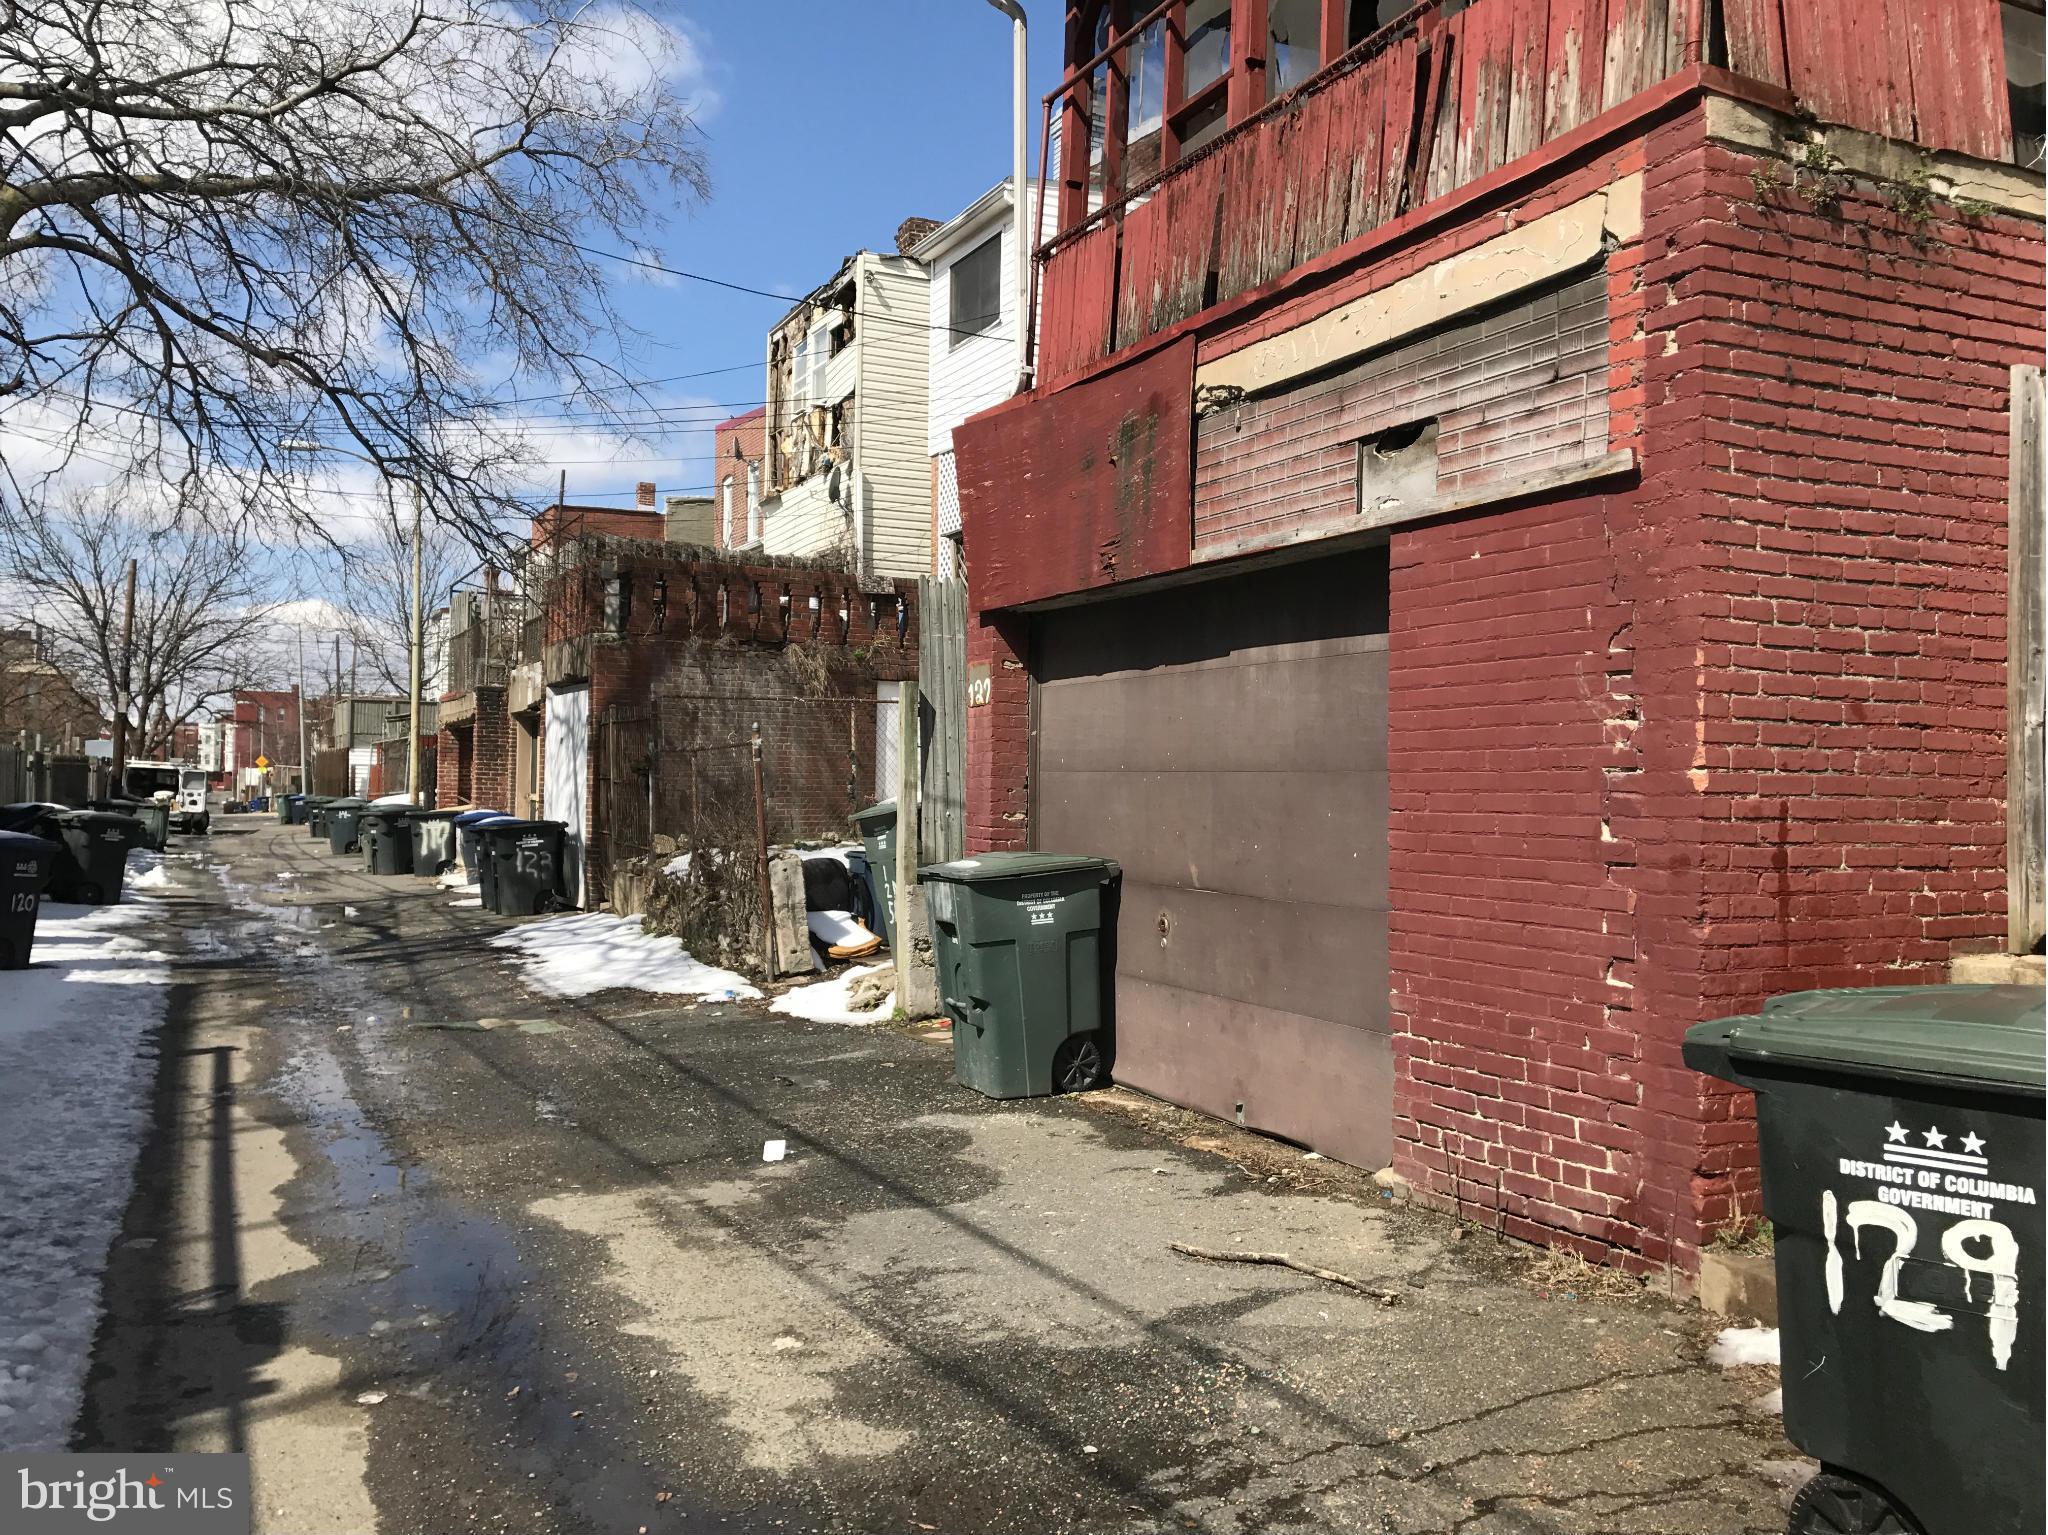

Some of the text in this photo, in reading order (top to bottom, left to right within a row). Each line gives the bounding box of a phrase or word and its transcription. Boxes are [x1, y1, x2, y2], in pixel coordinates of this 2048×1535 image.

[968, 678, 991, 707] 127
[12, 893, 34, 912] 120
[1839, 1158, 2036, 1205] DISTRICT OF COLUMBIA
[1877, 1185, 1993, 1219] GOVERNMENT
[1823, 1190, 2019, 1370] 129
